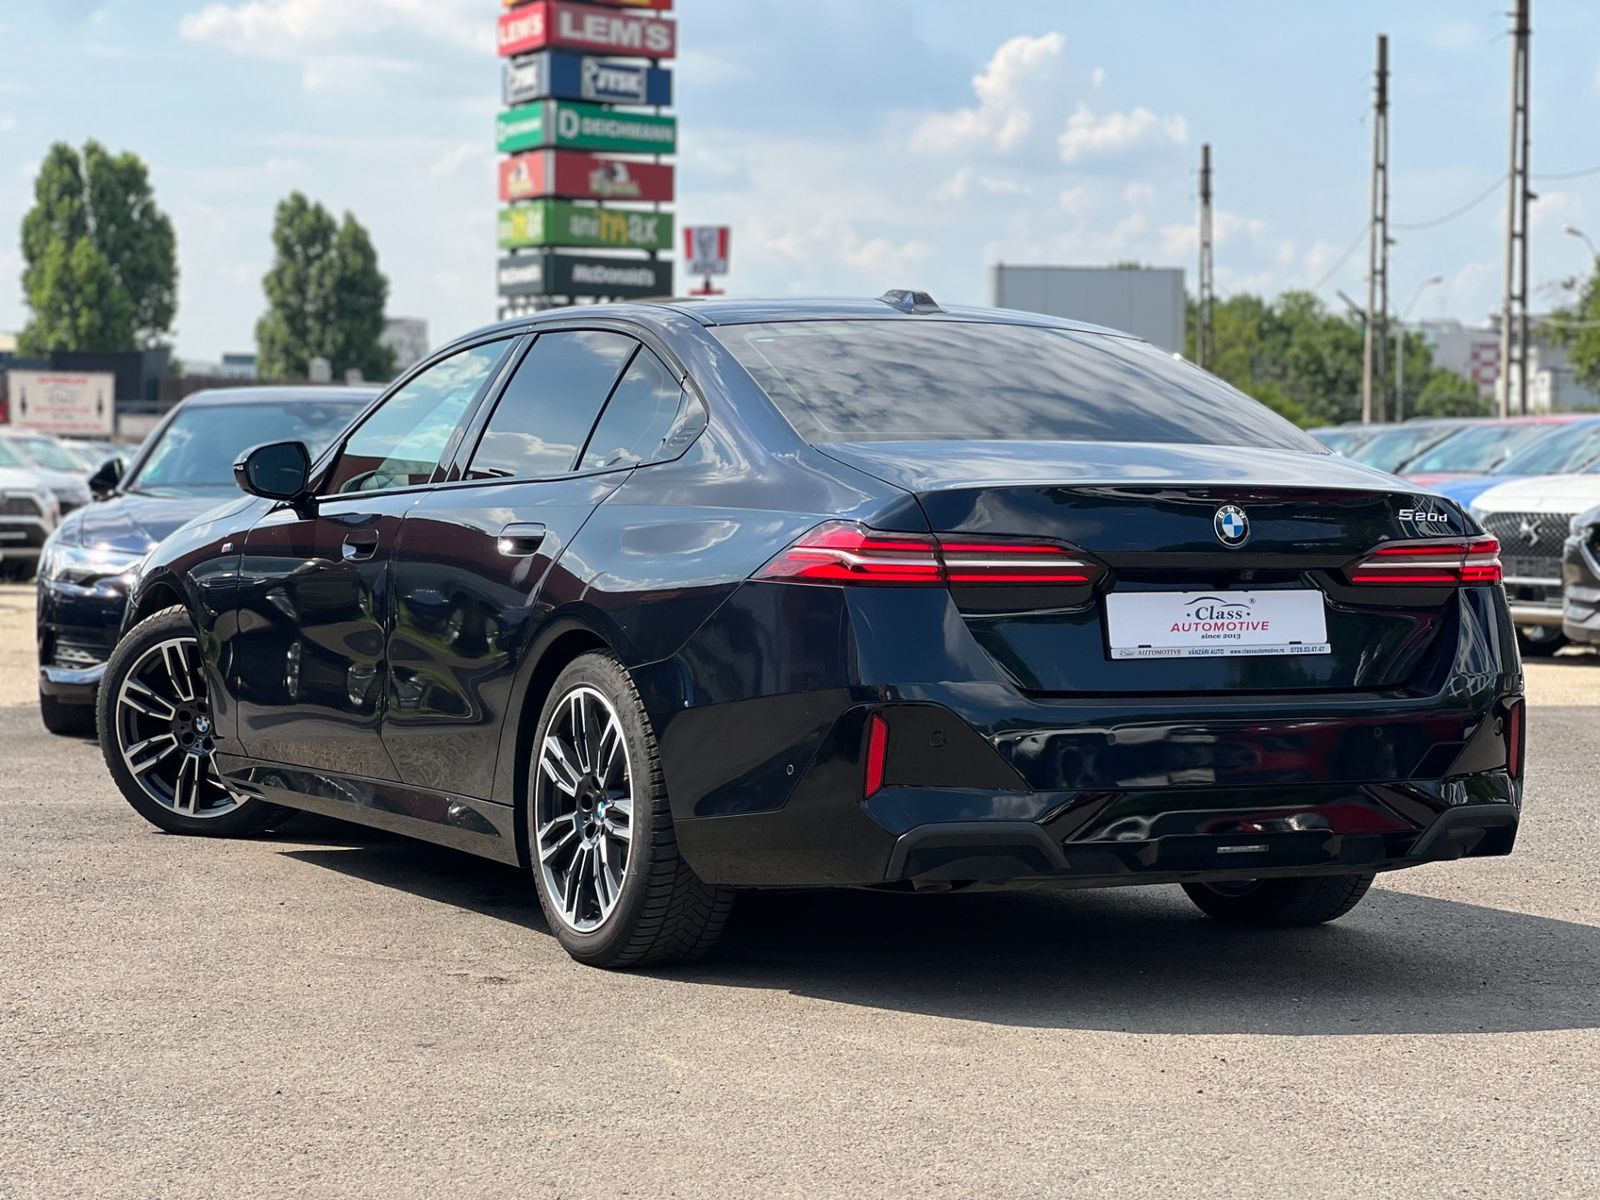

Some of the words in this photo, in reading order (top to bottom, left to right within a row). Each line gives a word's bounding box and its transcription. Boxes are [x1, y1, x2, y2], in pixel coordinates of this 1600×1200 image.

[558, 10, 672, 53] LEM'S
[582, 116, 675, 143] DEICHMANN
[1218, 506, 1246, 519] BMW
[1398, 508, 1448, 522] 520d
[1194, 605, 1243, 620] Class
[1170, 621, 1270, 632] AUTOMOTIVE
